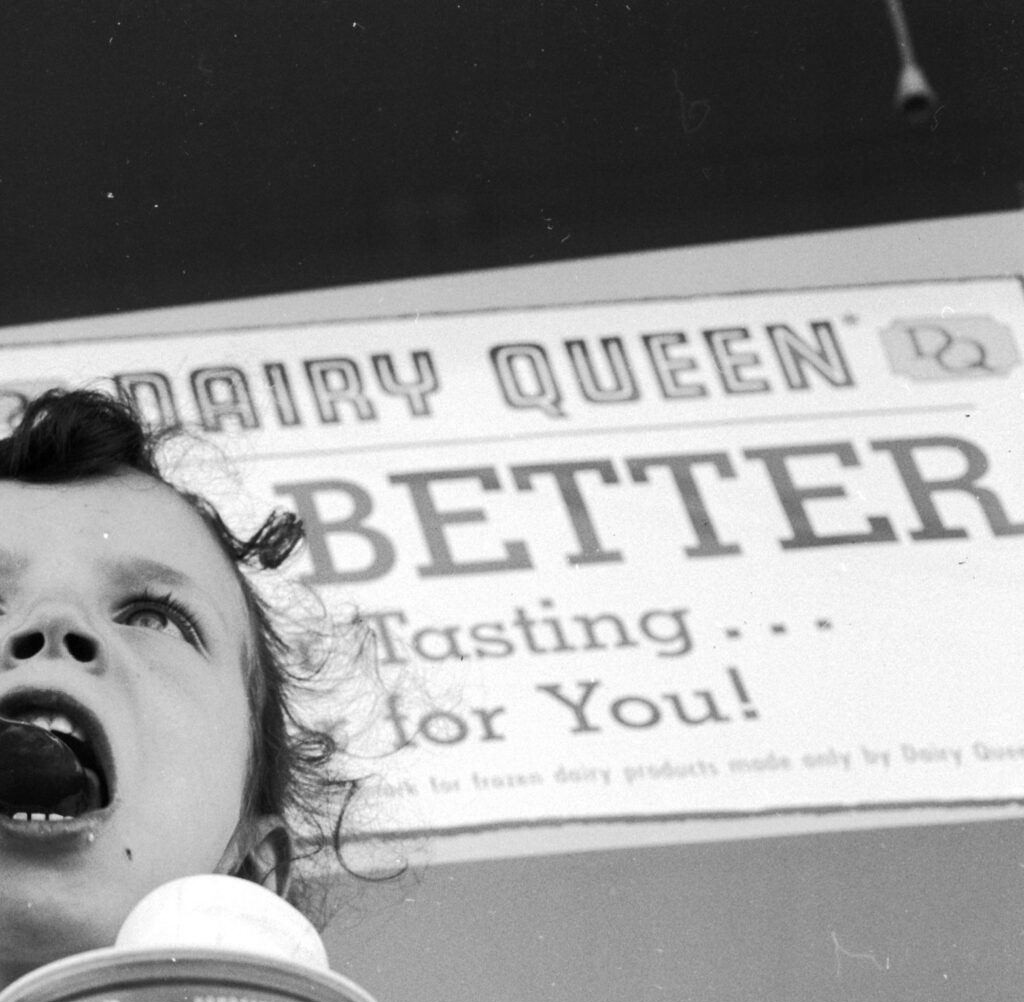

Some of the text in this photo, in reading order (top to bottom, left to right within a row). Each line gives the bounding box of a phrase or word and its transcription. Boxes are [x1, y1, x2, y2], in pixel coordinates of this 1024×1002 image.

[116, 350, 442, 433] DAIRY
[273, 435, 1024, 587] BETTER
[367, 598, 695, 667] Tasting
[387, 666, 760, 749] for You!
